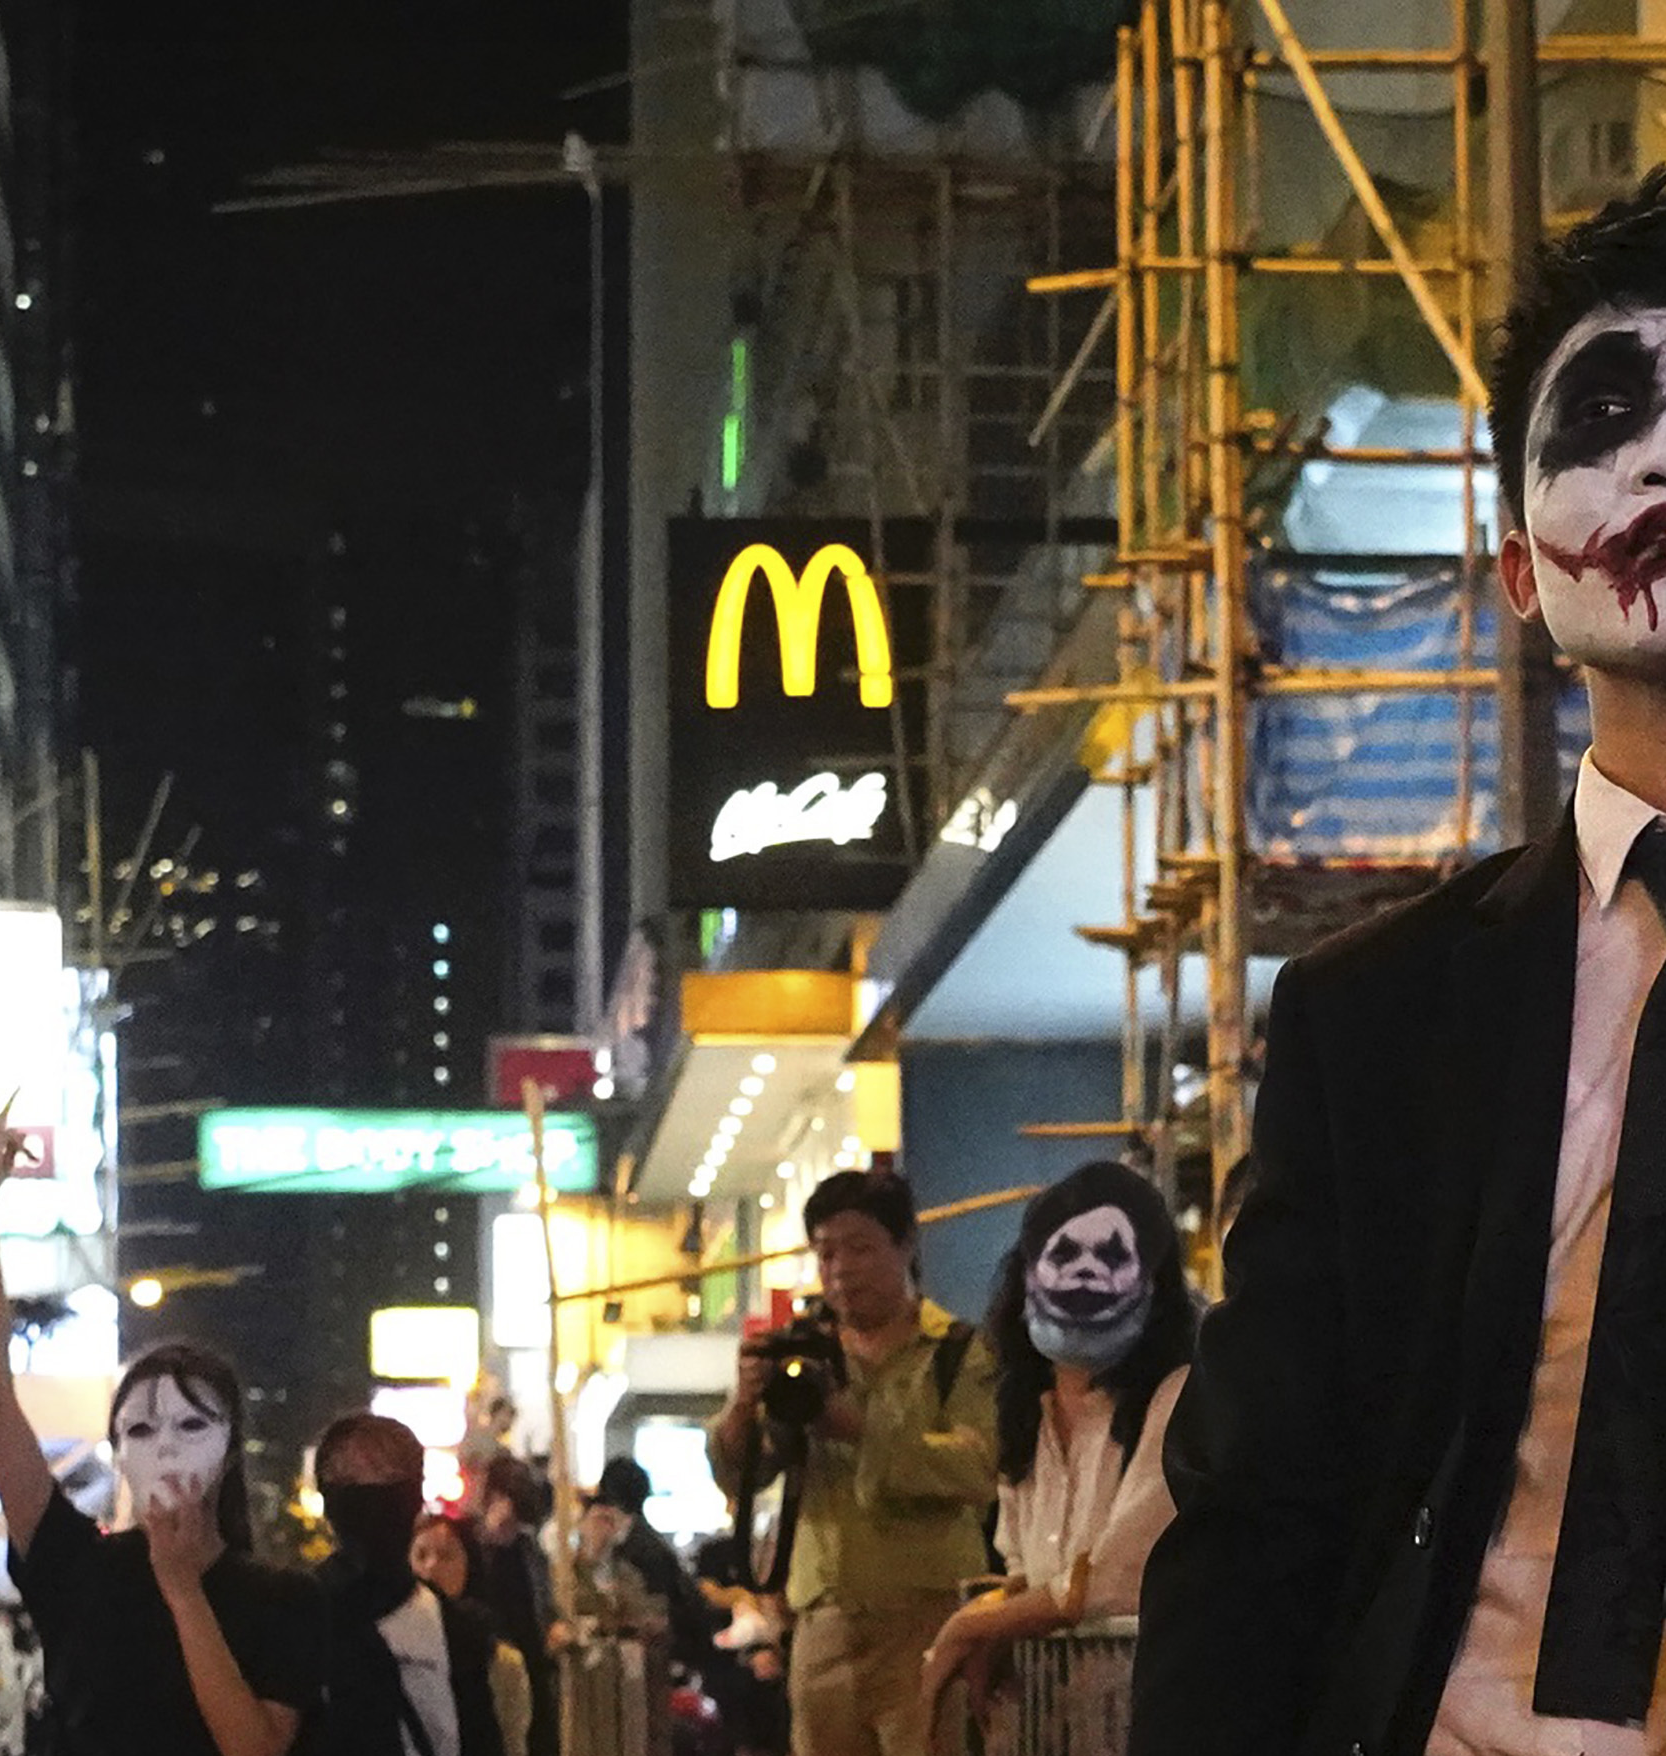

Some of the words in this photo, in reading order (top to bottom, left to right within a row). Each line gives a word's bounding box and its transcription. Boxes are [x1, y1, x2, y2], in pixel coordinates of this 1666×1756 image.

[212, 1126, 308, 1171] THE
[315, 1127, 445, 1172] BODY
[450, 1129, 578, 1173] SHOP
